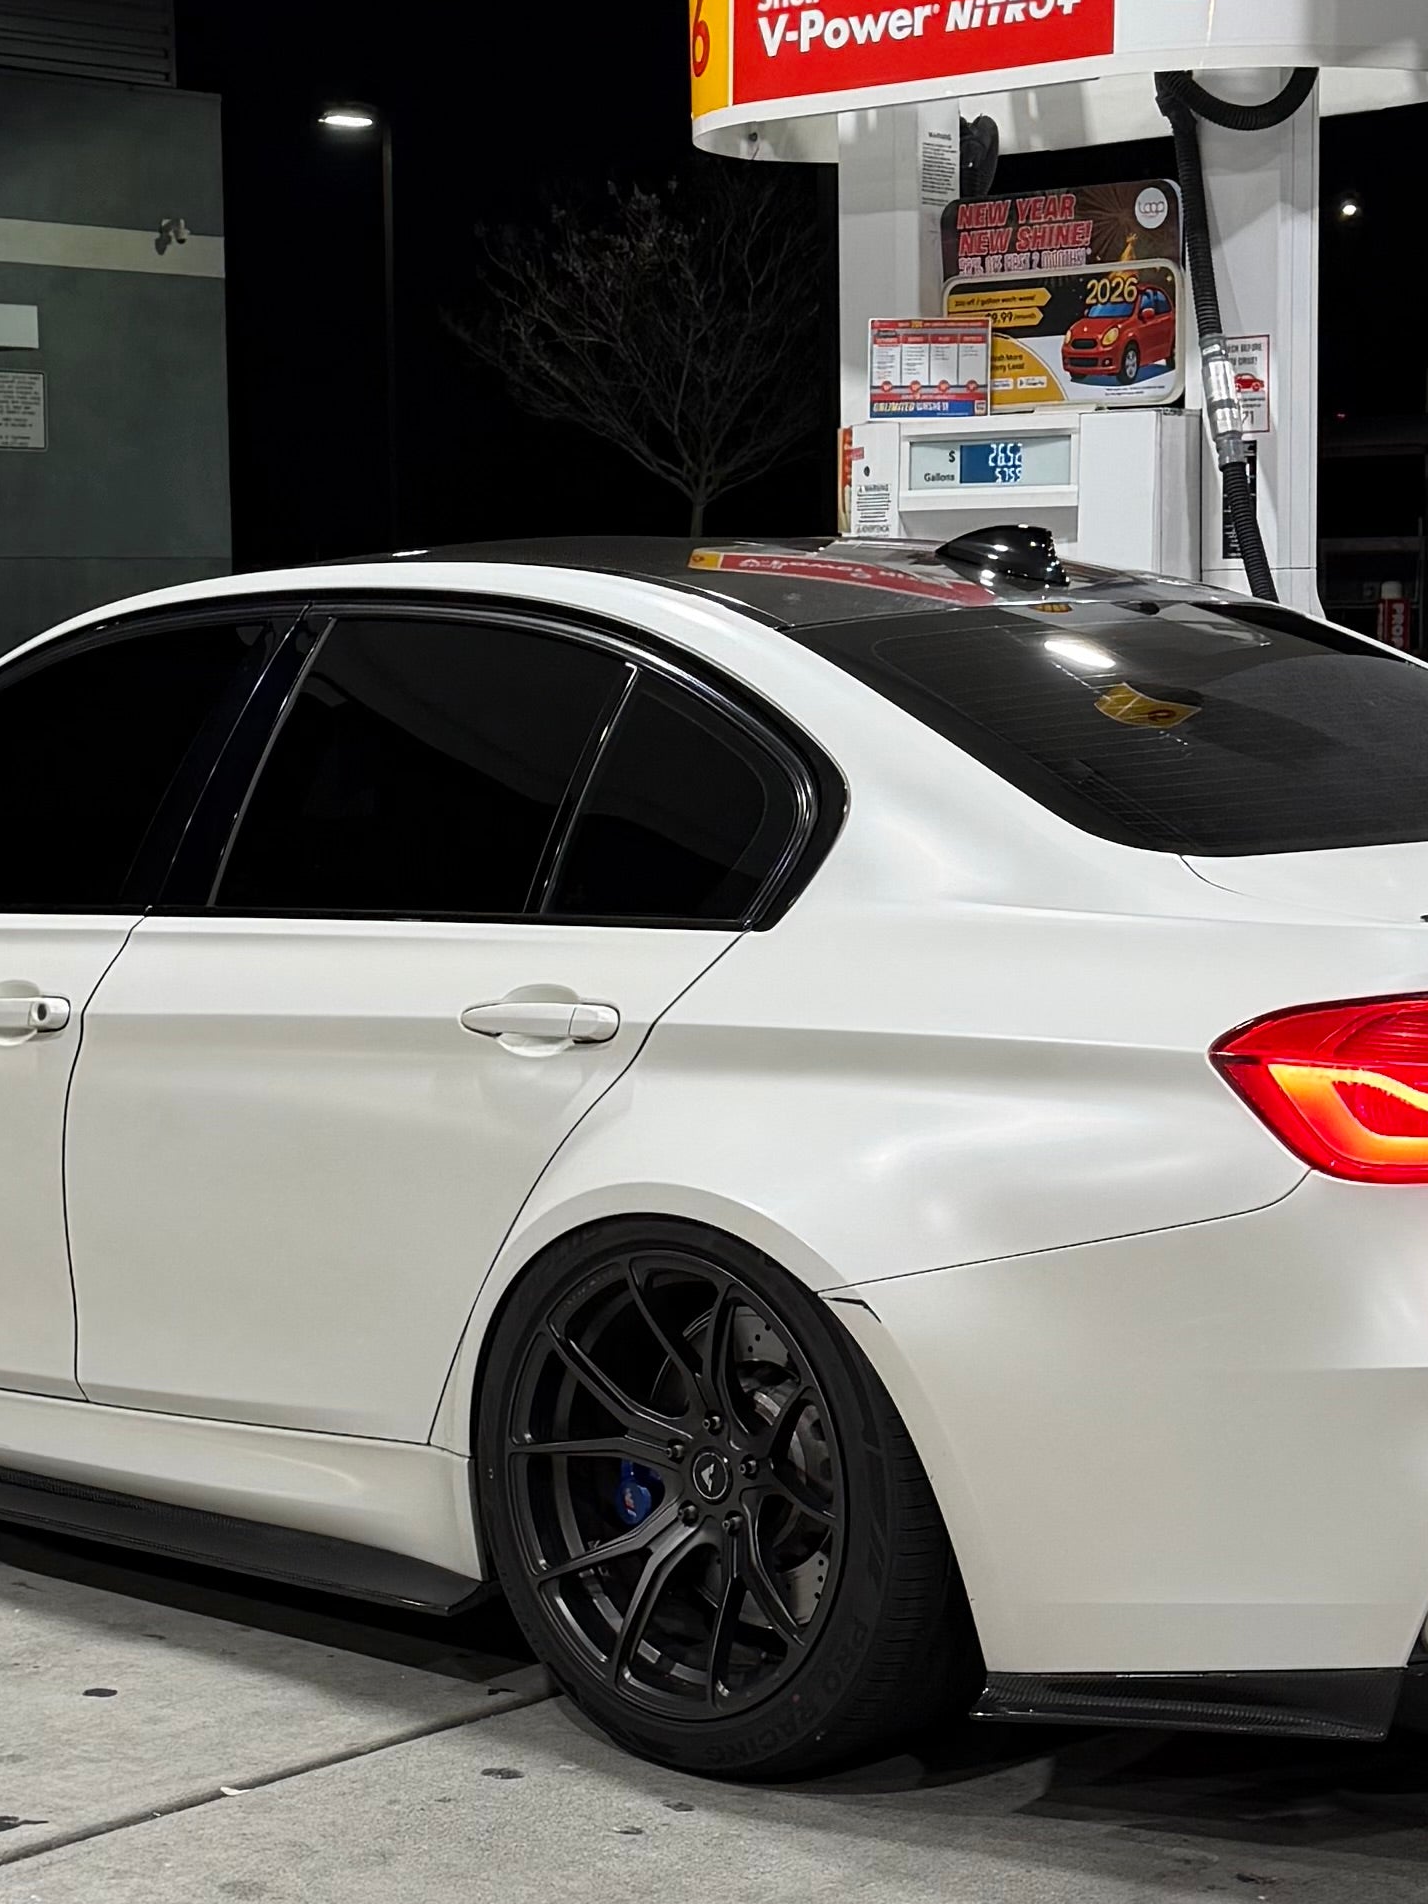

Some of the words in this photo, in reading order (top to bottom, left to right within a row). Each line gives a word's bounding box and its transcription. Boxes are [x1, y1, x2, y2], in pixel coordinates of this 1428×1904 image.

[758, 6, 932, 57] V-Power
[957, 199, 1011, 230] NEW
[1015, 193, 1076, 225] YEAR
[958, 227, 1013, 257] NEW
[1016, 220, 1093, 252] SHINE!
[1085, 276, 1139, 304] 2026
[949, 450, 956, 463] $
[924, 473, 955, 482] Gallons
